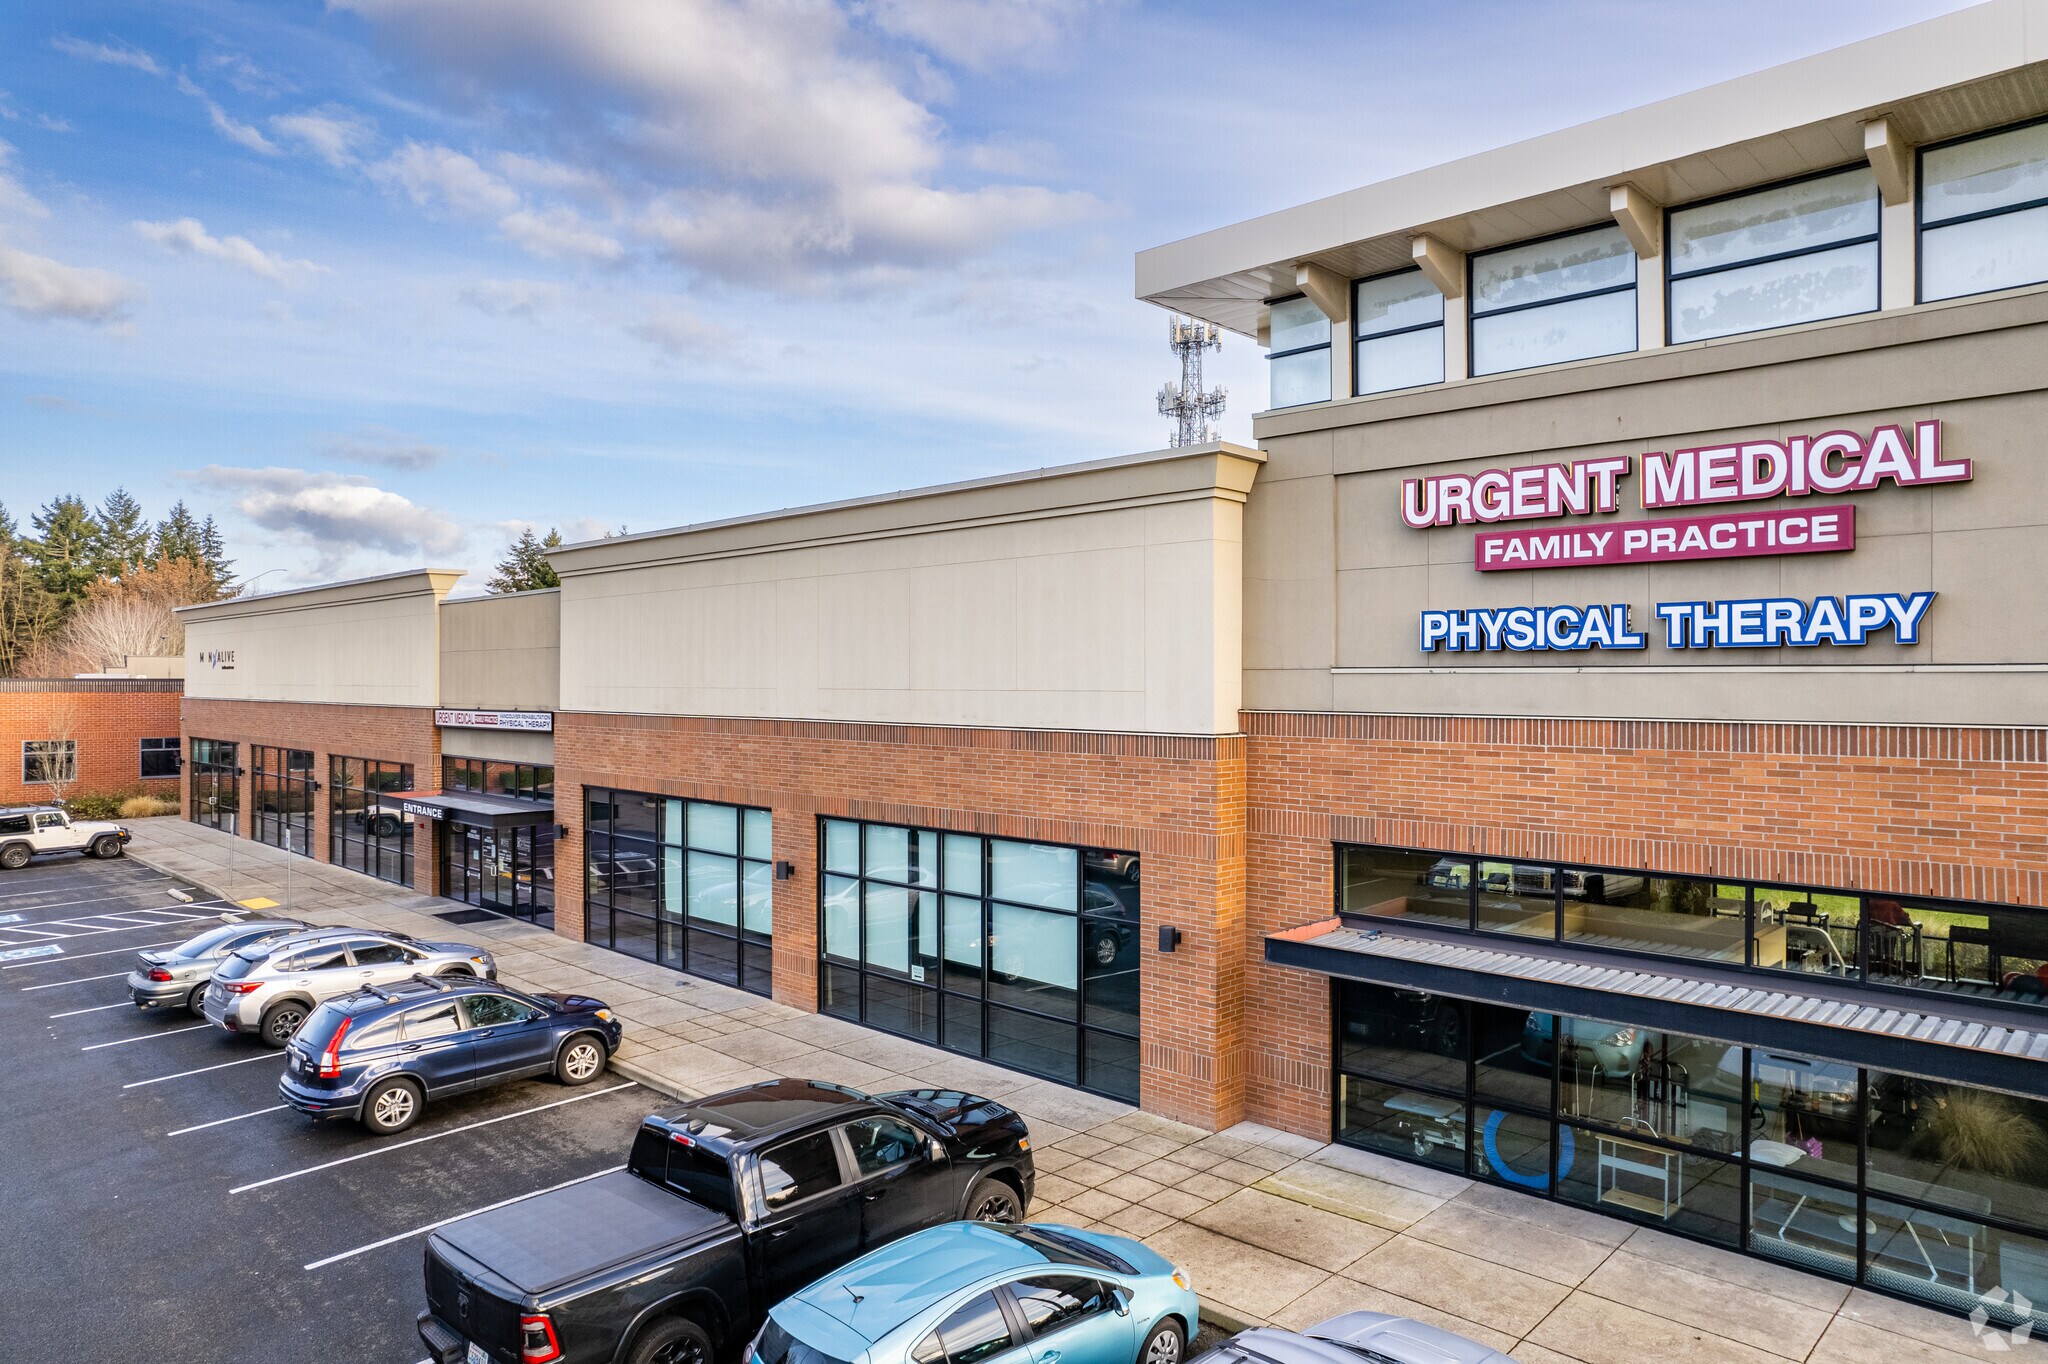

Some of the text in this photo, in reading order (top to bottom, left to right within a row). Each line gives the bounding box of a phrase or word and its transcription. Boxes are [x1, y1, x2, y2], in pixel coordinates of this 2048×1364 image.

[1403, 421, 1969, 527] URGENT MEDICAL
[1485, 514, 1838, 563] FAMILY PRACTICE
[1422, 594, 1936, 649] PHYSICAL THERAPY
[436, 711, 475, 725] URGENT MEDICAL
[500, 719, 551, 728] PHYSICAL THERAPY
[403, 802, 442, 818] ENTRANCE
